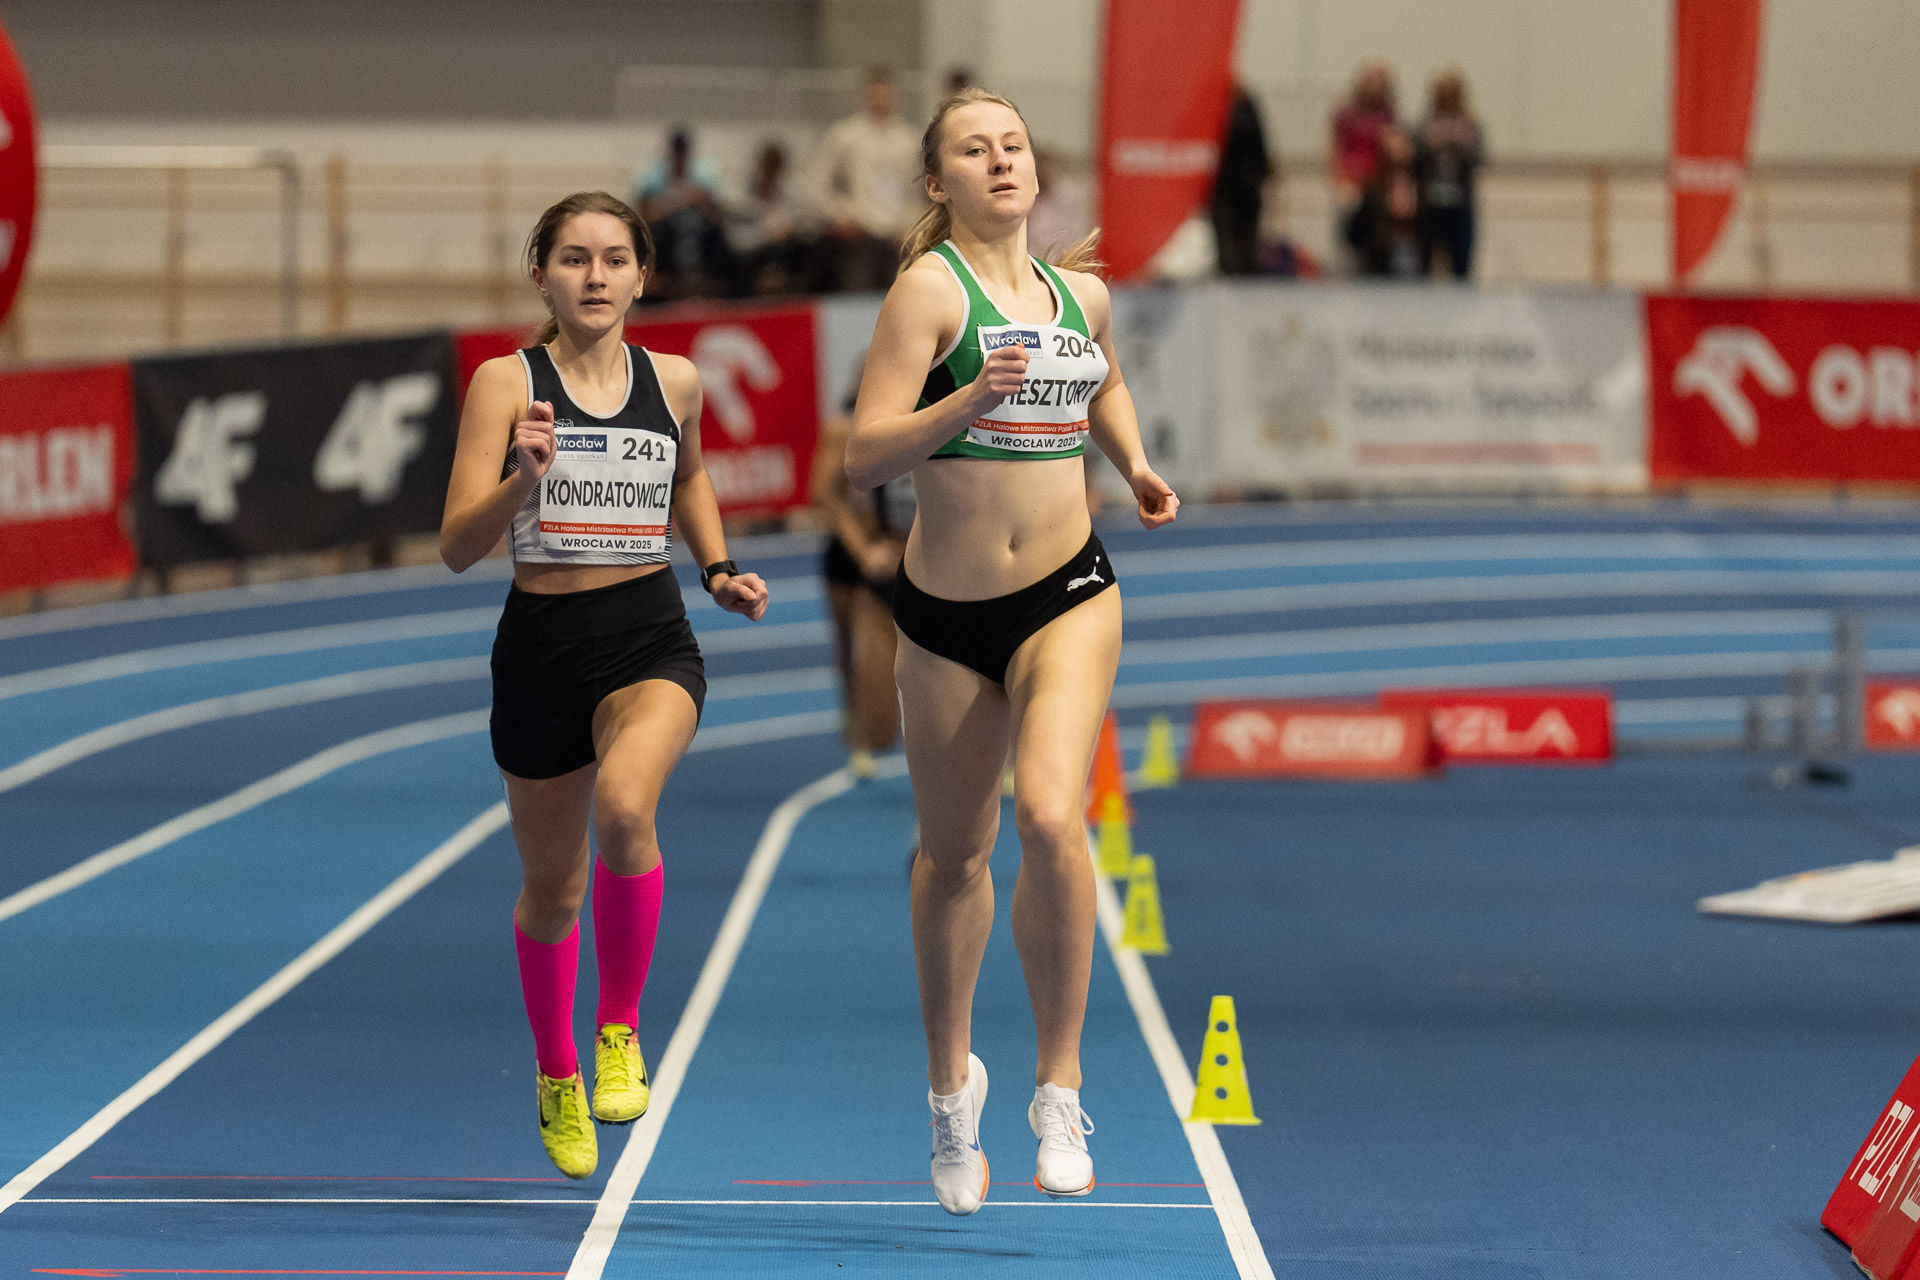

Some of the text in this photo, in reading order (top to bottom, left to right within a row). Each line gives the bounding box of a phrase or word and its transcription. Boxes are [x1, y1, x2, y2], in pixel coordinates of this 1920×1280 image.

[987, 332, 1096, 359] Wrocław 204
[1001, 378, 1100, 406] ESZTORT
[1809, 345, 1920, 429] OR
[313, 371, 441, 503] 4F
[975, 420, 992, 429] PZLA
[993, 424, 1020, 432] Halowe
[1021, 425, 1057, 433] Mistrzostwa
[622, 437, 666, 462] 241
[991, 436, 1056, 448] WROCŁAW
[155, 391, 268, 523] 4F
[546, 479, 669, 509] KONDRATOWICZ
[561, 538, 652, 549] WROCŁAW 2025
[586, 526, 626, 534] Mistrzostwa
